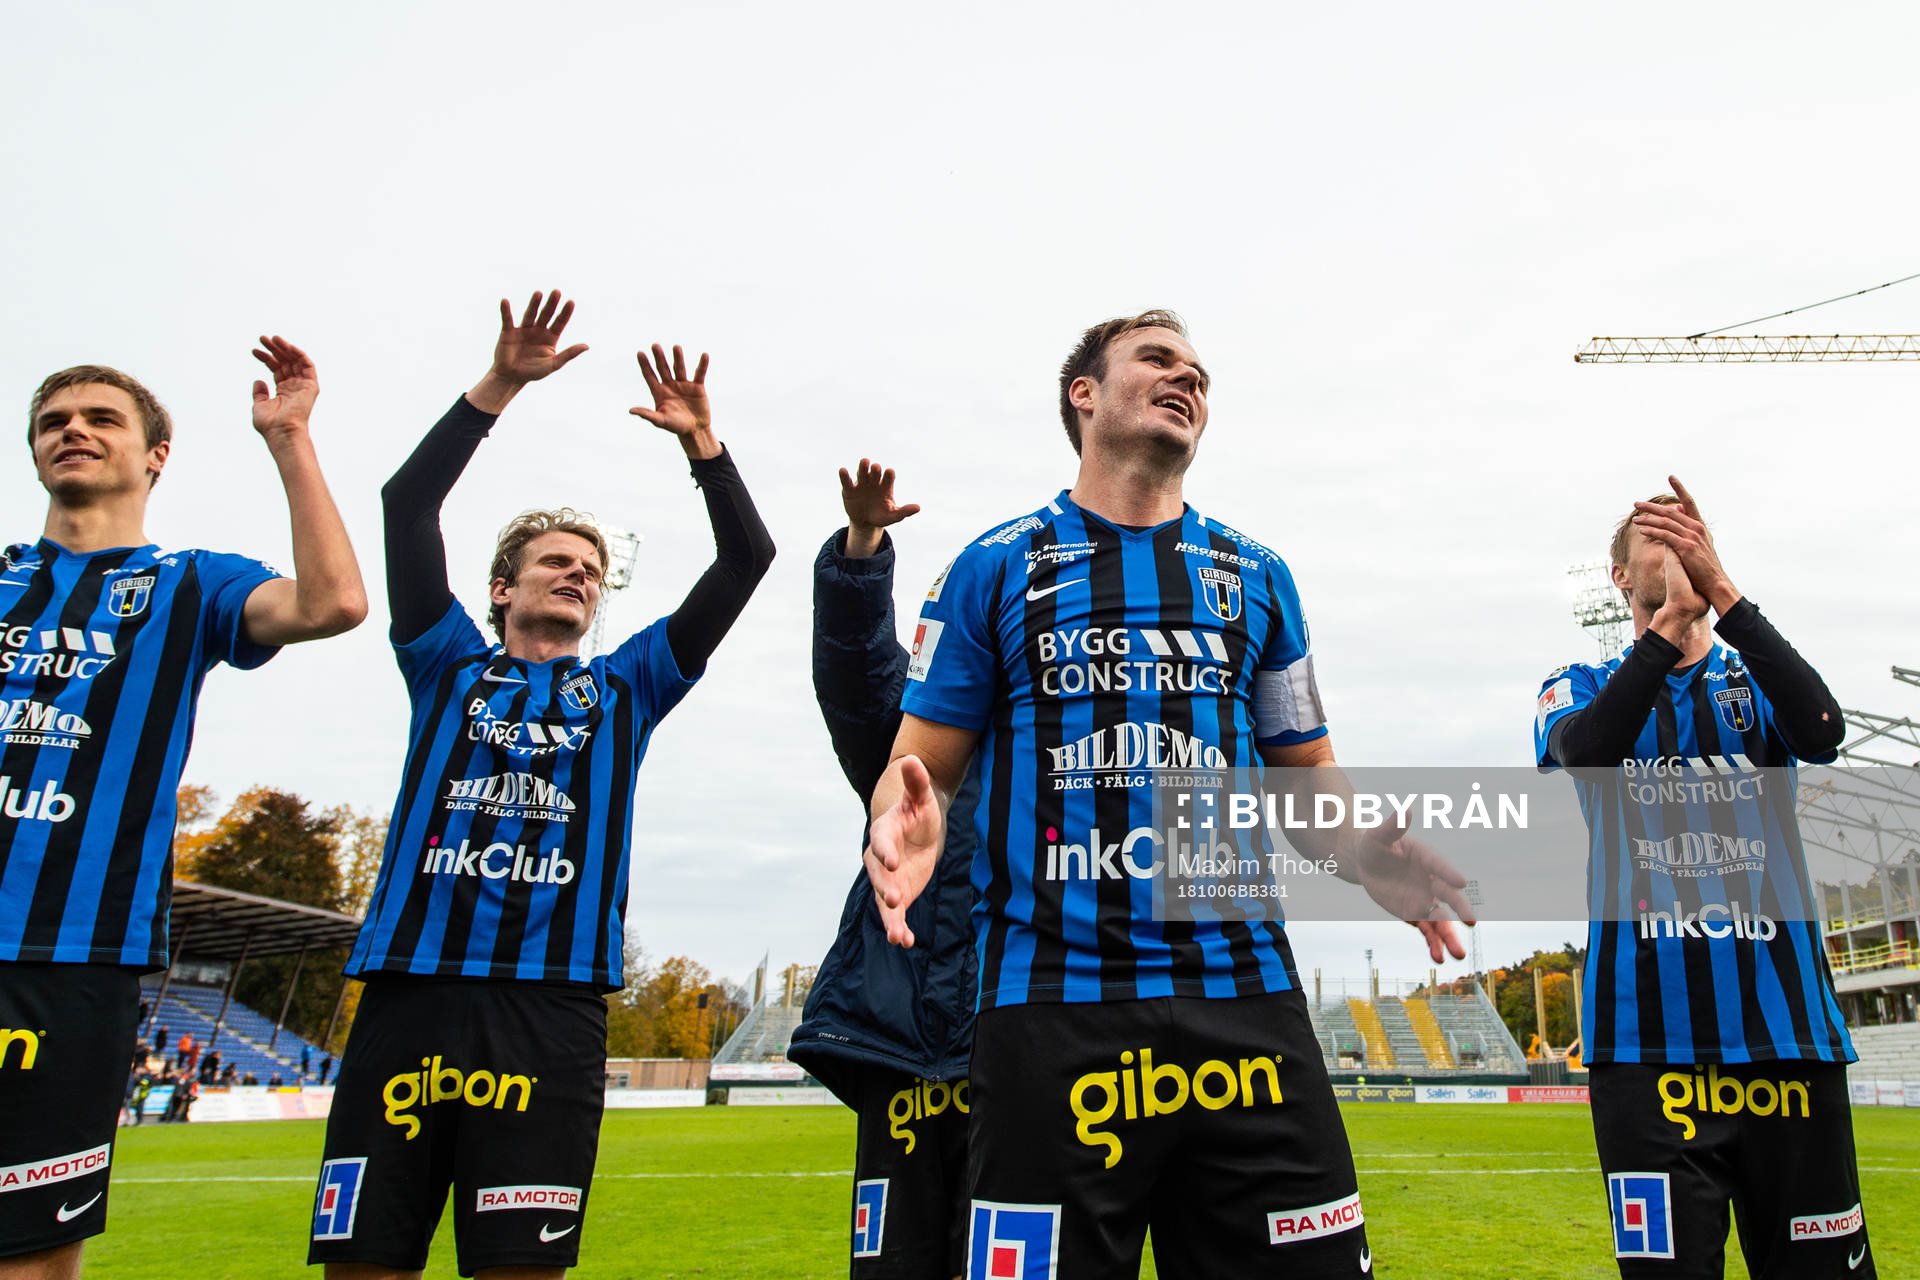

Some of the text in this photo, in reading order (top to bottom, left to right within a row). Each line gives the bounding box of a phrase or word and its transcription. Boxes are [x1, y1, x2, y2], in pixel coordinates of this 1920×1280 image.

[1043, 541, 1098, 551] Supermarket
[114, 577, 150, 589] SIRIUS
[1203, 569, 1237, 583] SIRIUS
[1038, 628, 1130, 662] BYGG
[0, 651, 117, 679] STRUCT
[1042, 662, 1232, 695] CONSTRUCT
[1717, 689, 1747, 701] SIRIUS
[3, 734, 80, 749] BILDELAR
[1046, 722, 1227, 771] BILDEMO
[1054, 774, 1223, 790] DÄCK FÄLG BILDELAR
[1623, 756, 1683, 779] BYGG
[448, 772, 576, 810] BILDEMO
[1628, 774, 1764, 805] CONSTRUCT
[445, 800, 478, 811] DÄCK
[484, 805, 515, 817] FÄLG
[423, 835, 575, 884] inkClub
[1046, 826, 1233, 881] inkClub
[1639, 860, 1669, 875] DÄCK
[1677, 869, 1708, 877] FÄLG
[1638, 899, 1777, 942] inkClub
[383, 1055, 532, 1141] gibon
[1334, 1087, 1352, 1097] bon
[1658, 1064, 1810, 1141] gibon
[1070, 1048, 1283, 1169] gibon
[27, 1151, 106, 1182] MOTOR
[482, 1191, 578, 1206] RA MOTOR
[1276, 1200, 1363, 1236] RA MOT
[1793, 1221, 1823, 1235] RA
